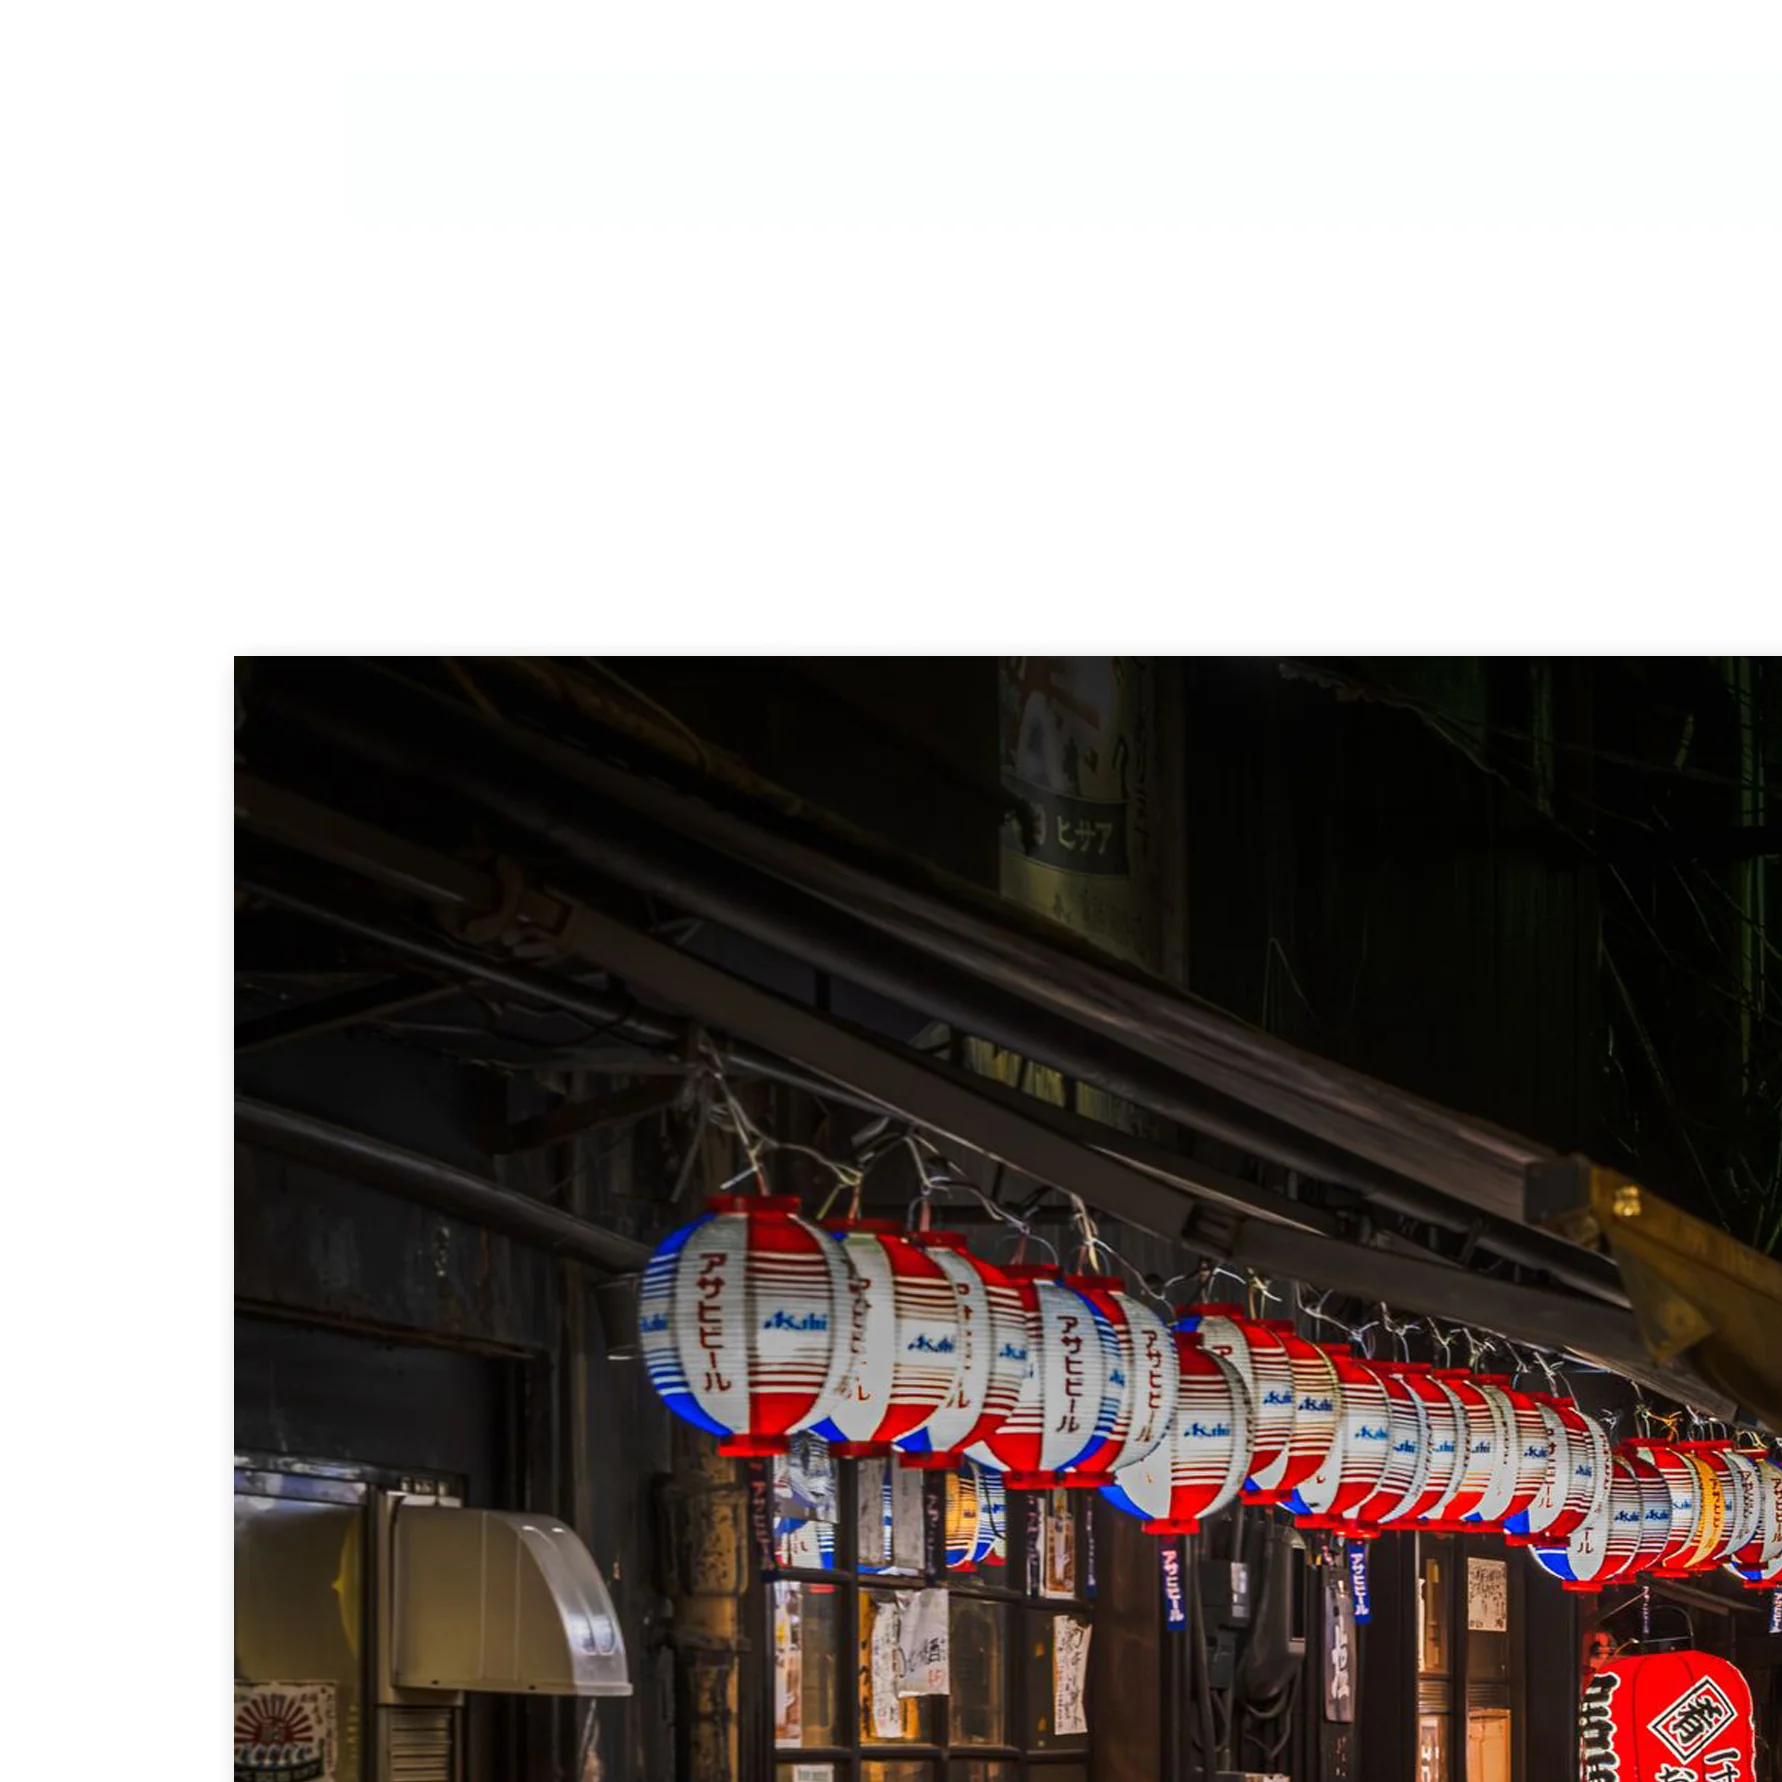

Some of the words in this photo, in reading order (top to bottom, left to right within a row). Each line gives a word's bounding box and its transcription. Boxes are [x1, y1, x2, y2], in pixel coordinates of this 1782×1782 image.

[696, 1253, 731, 1392] アサヒビール
[763, 1311, 828, 1331] Asahi
[1056, 1315, 1084, 1434] アサヒビール
[1135, 1330, 1163, 1443] アサヒビール
[1183, 1422, 1231, 1438] Asahi
[1771, 1478, 1782, 1544] アサヒビール
[1161, 1550, 1185, 1622] アサヒビール
[1349, 1552, 1369, 1616] アサヒビール
